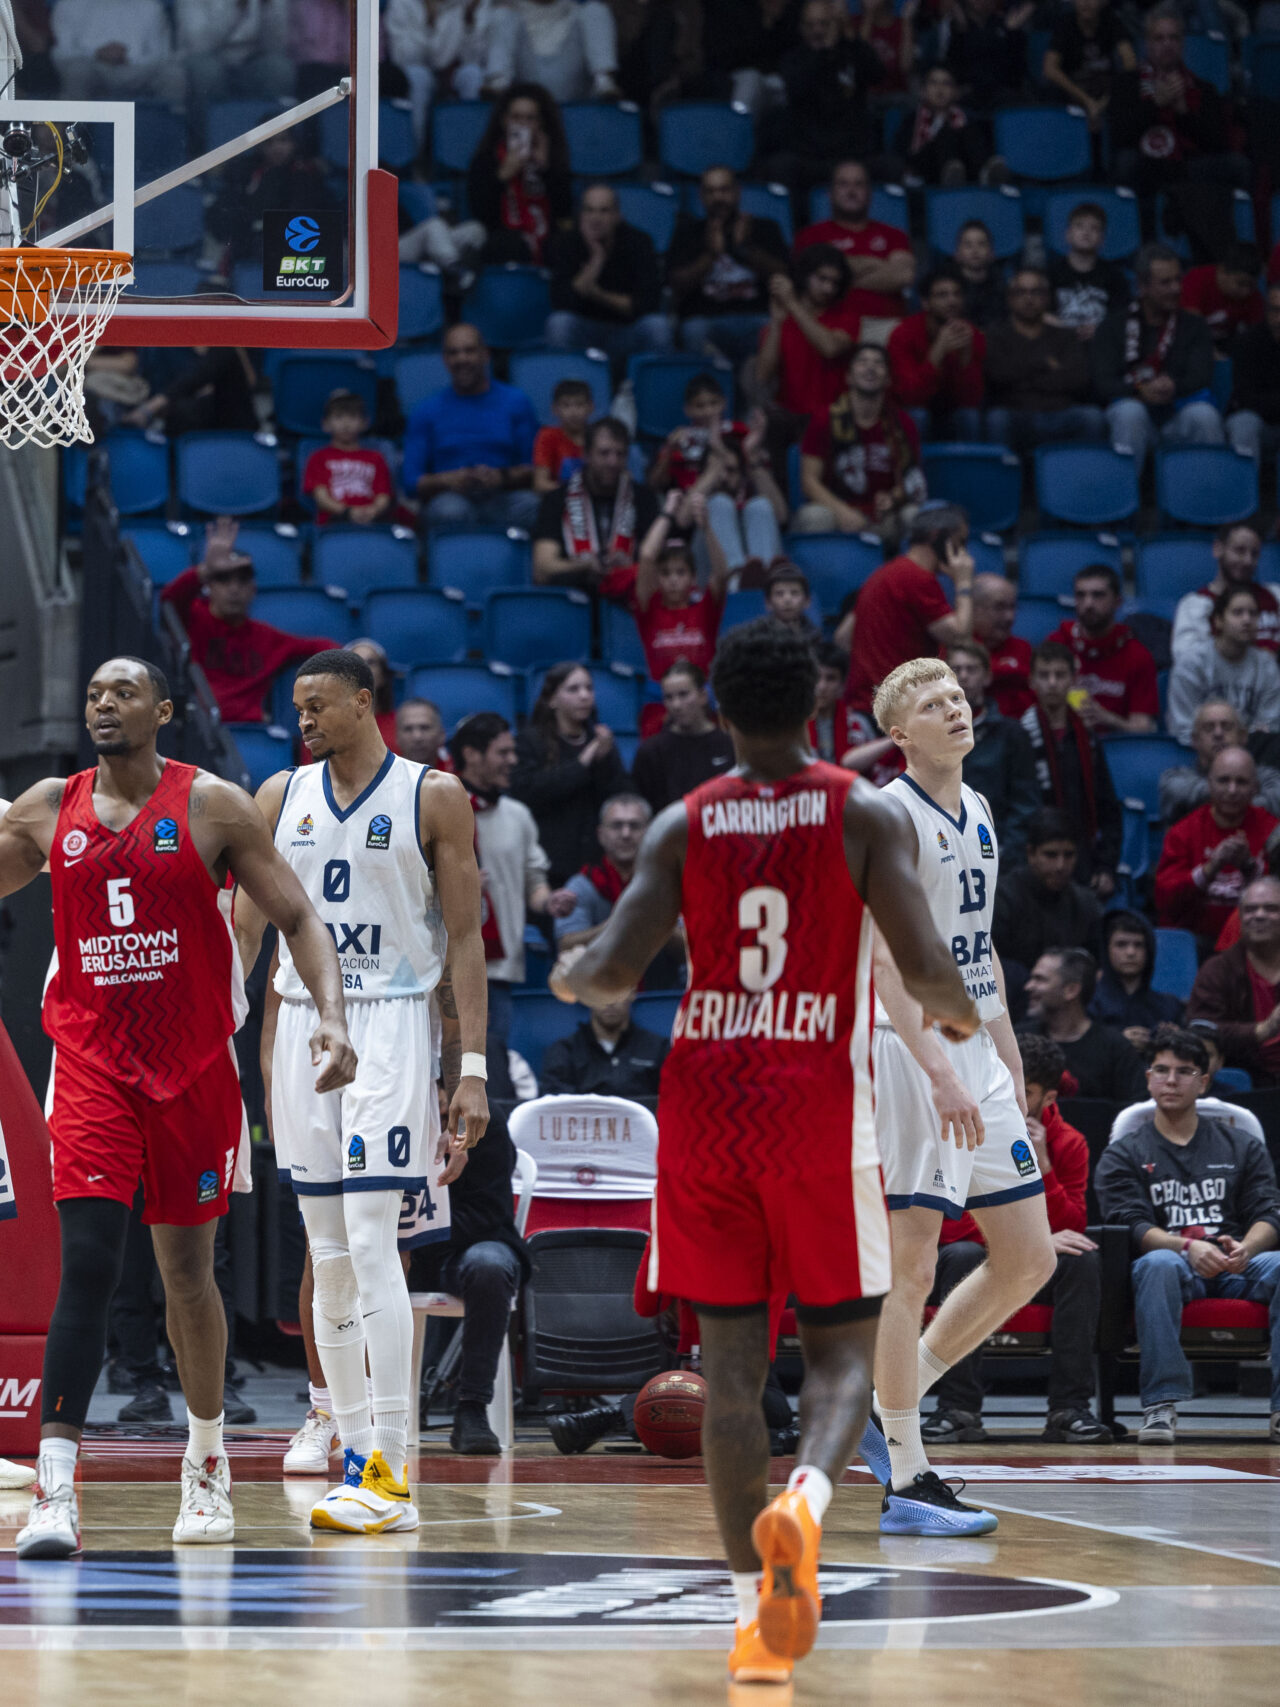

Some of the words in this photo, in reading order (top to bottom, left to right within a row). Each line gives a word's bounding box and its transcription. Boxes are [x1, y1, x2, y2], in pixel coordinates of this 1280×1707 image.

[281, 259, 324, 270] BKT
[276, 276, 329, 290] EuroCup
[701, 790, 828, 839] CARRINGTON
[323, 859, 351, 903] 0
[958, 868, 986, 914] 13
[106, 877, 135, 928] 5
[78, 928, 178, 955] MIDTOWN
[738, 885, 789, 993] 3
[952, 931, 993, 967] BA
[81, 947, 179, 973] JERUSALEM
[387, 1125, 411, 1168] 0
[539, 1116, 632, 1142] LUCIANA
[1149, 1178, 1226, 1206] CHICAGO
